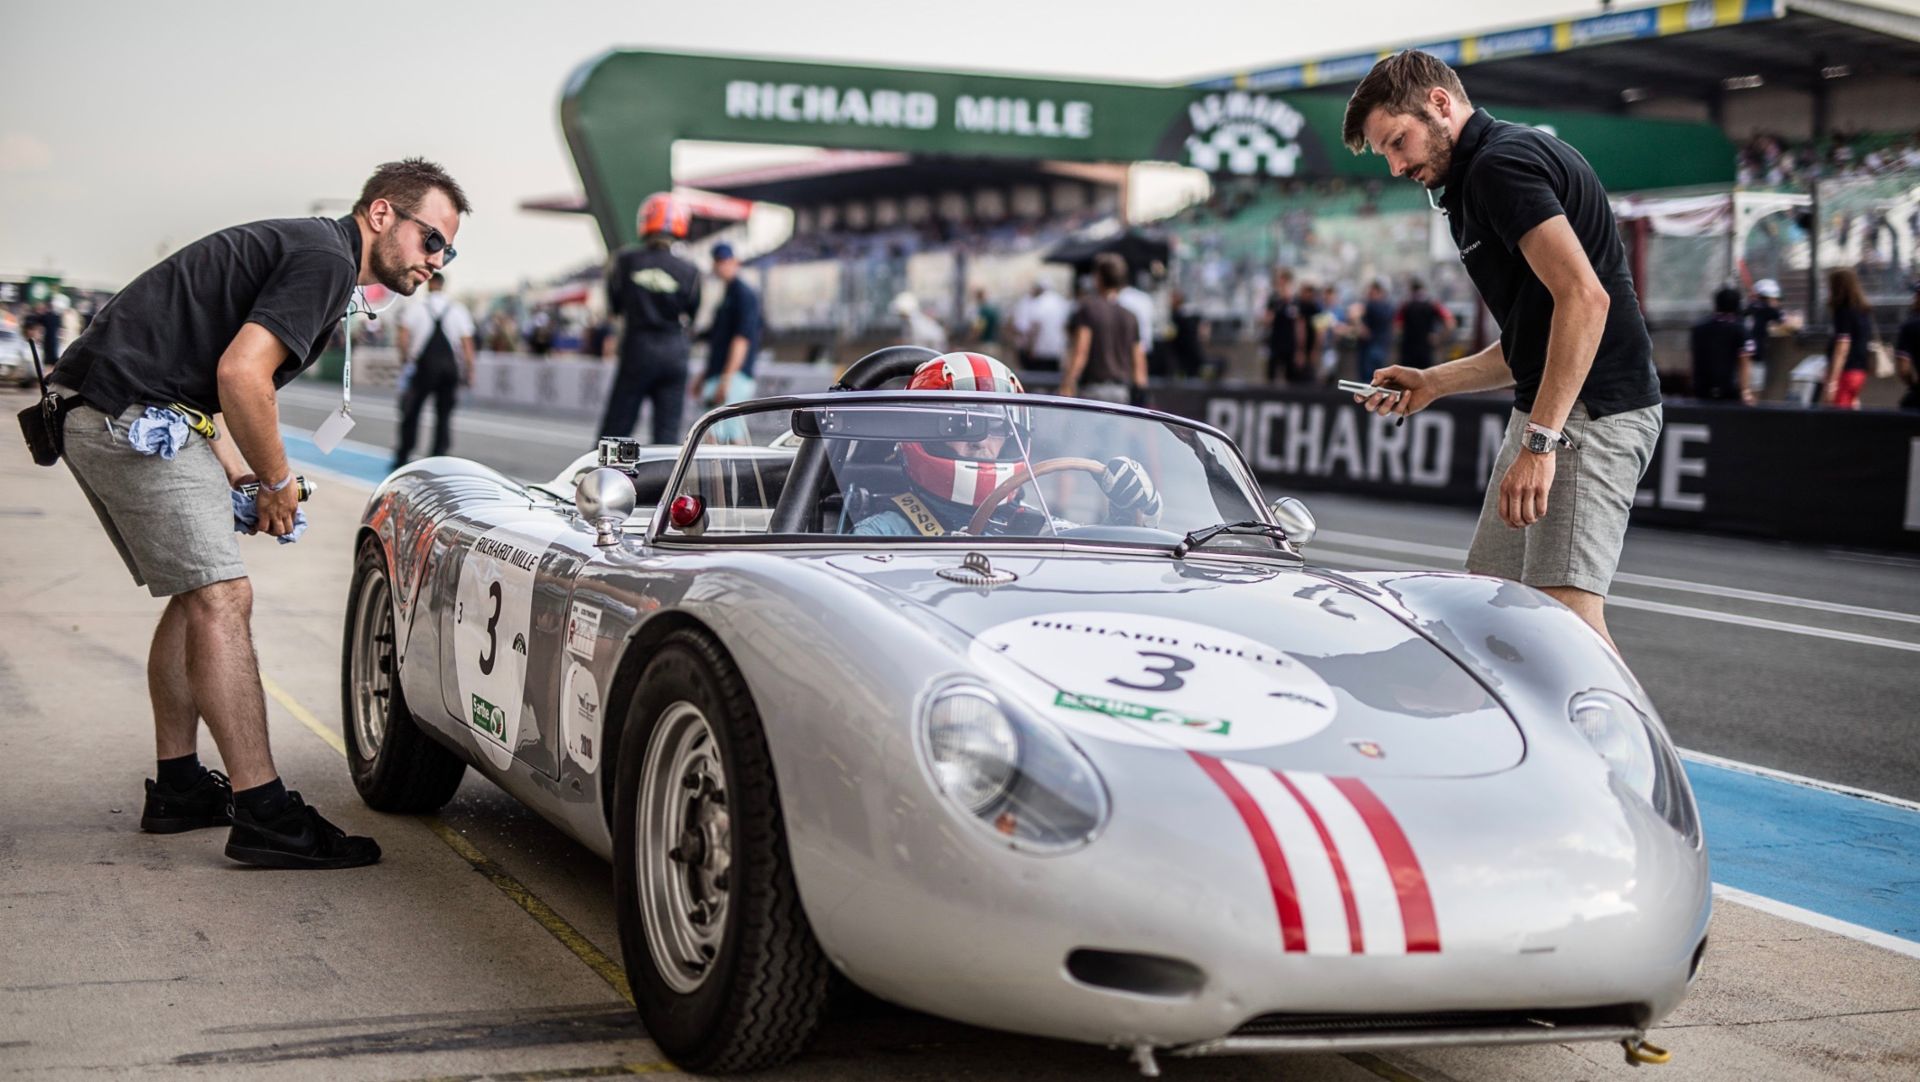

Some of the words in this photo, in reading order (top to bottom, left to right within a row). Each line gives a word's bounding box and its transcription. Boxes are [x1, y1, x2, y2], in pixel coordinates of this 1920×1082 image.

[726, 80, 939, 130] RICHARD
[955, 94, 1094, 140] MILLE
[1206, 399, 1456, 488] RICHARD
[901, 496, 939, 536] Sabe
[475, 536, 514, 562] RICHARD
[509, 548, 539, 572] MILLE
[458, 602, 463, 624] 3
[479, 581, 502, 675] 3
[1031, 620, 1179, 646] RICHARD
[1193, 642, 1292, 669] MILLE
[1106, 650, 1195, 692] 3
